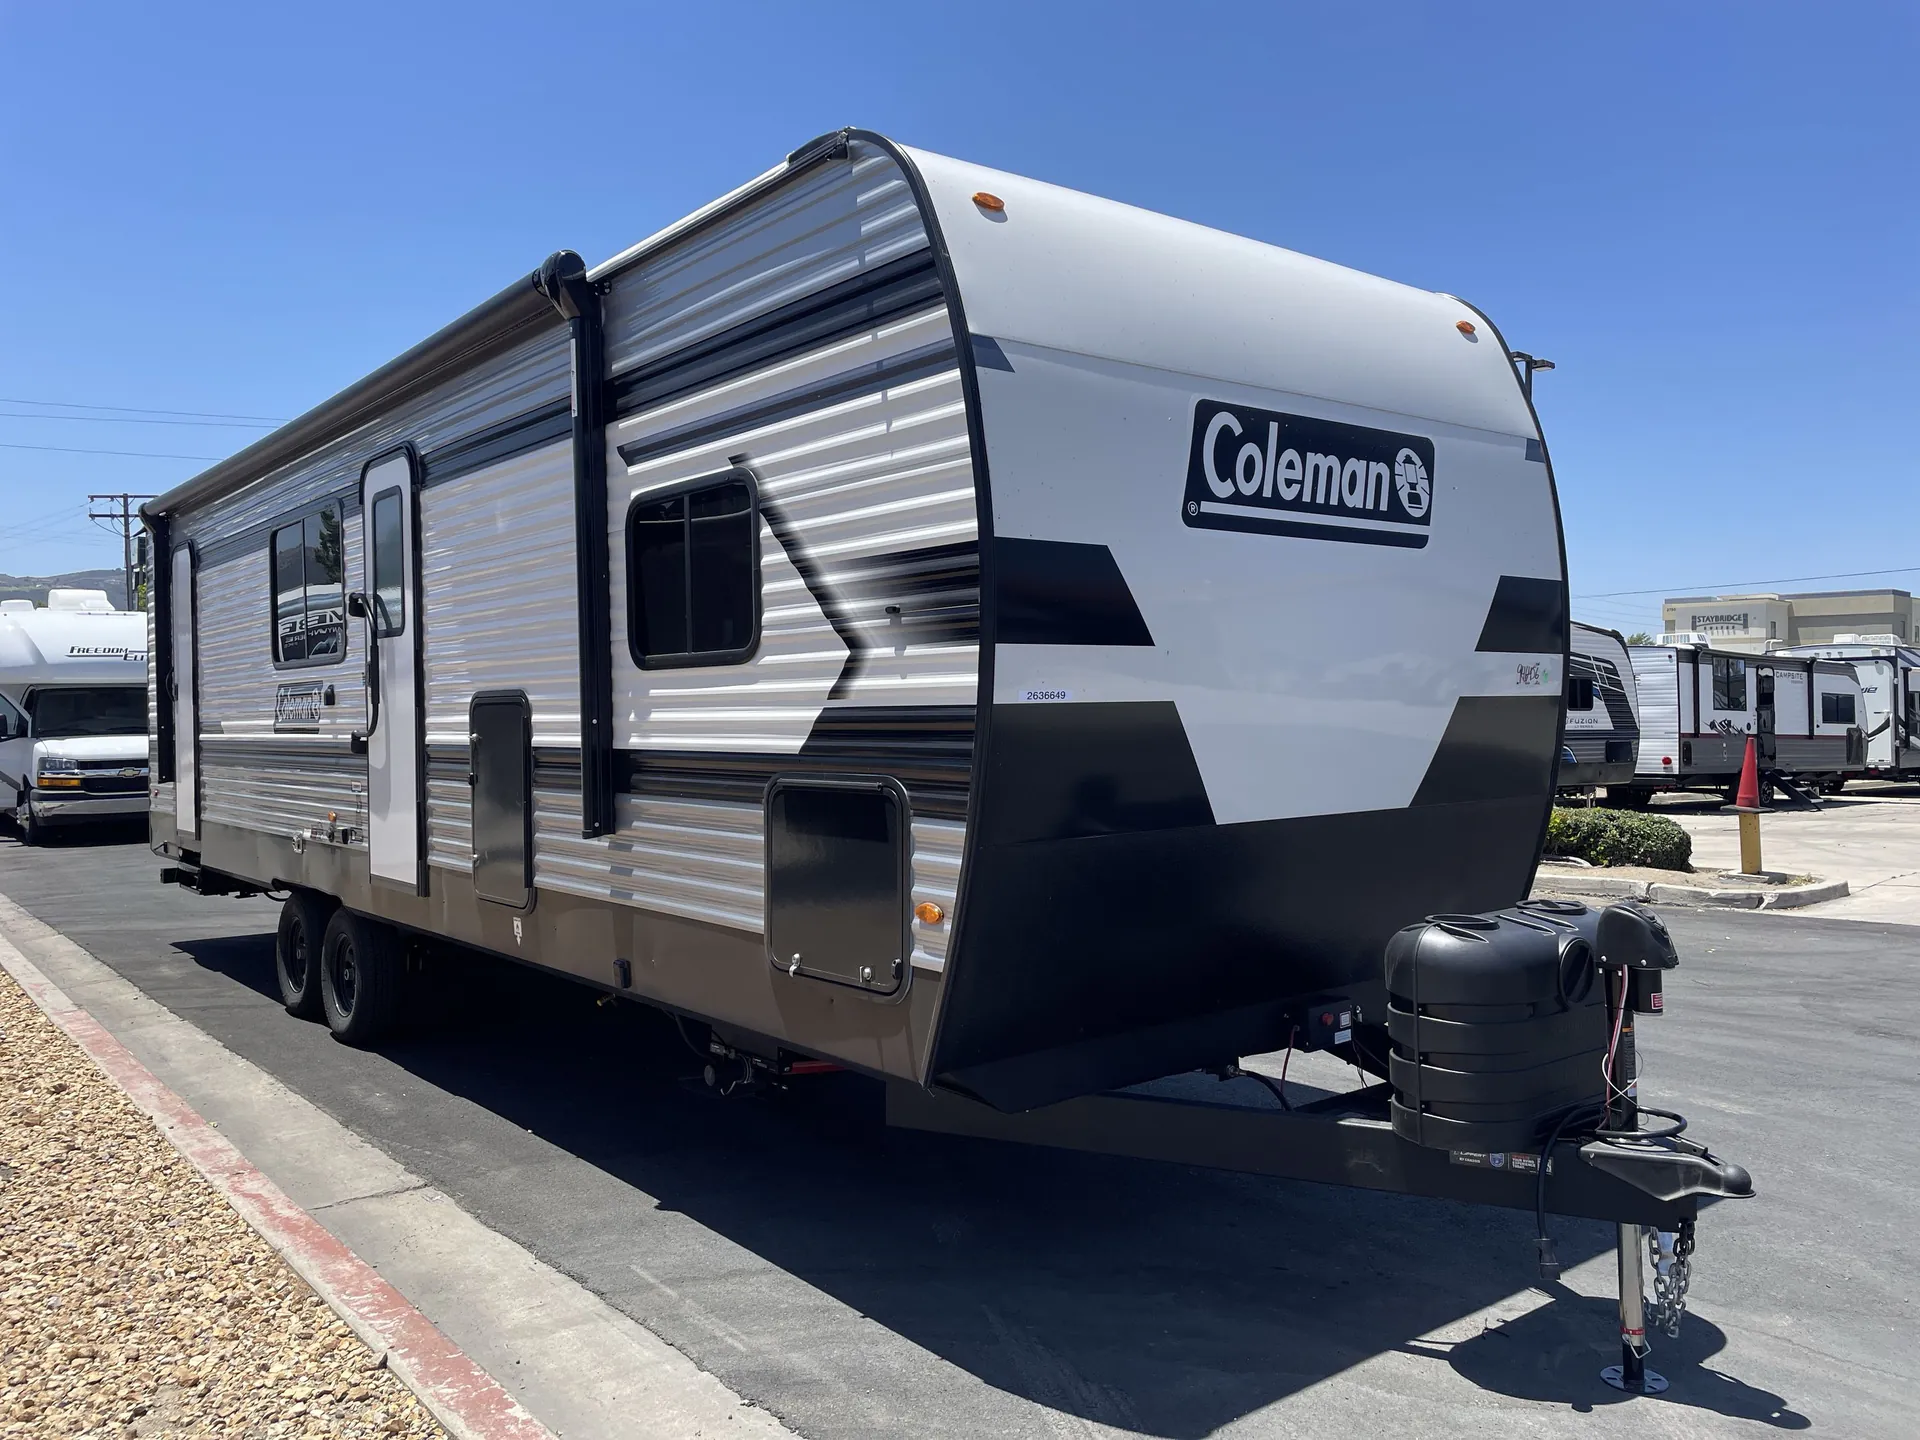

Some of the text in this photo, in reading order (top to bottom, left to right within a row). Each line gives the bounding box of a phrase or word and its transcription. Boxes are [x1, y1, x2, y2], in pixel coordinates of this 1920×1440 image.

[1203, 411, 1391, 512] Coleman
[1697, 614, 1742, 623] STAYBRIDGE
[69, 646, 128, 654] FREEDOM
[1775, 671, 1804, 681] CAMPSITE
[1027, 690, 1066, 700] 2636649
[277, 687, 312, 722] Coleman
